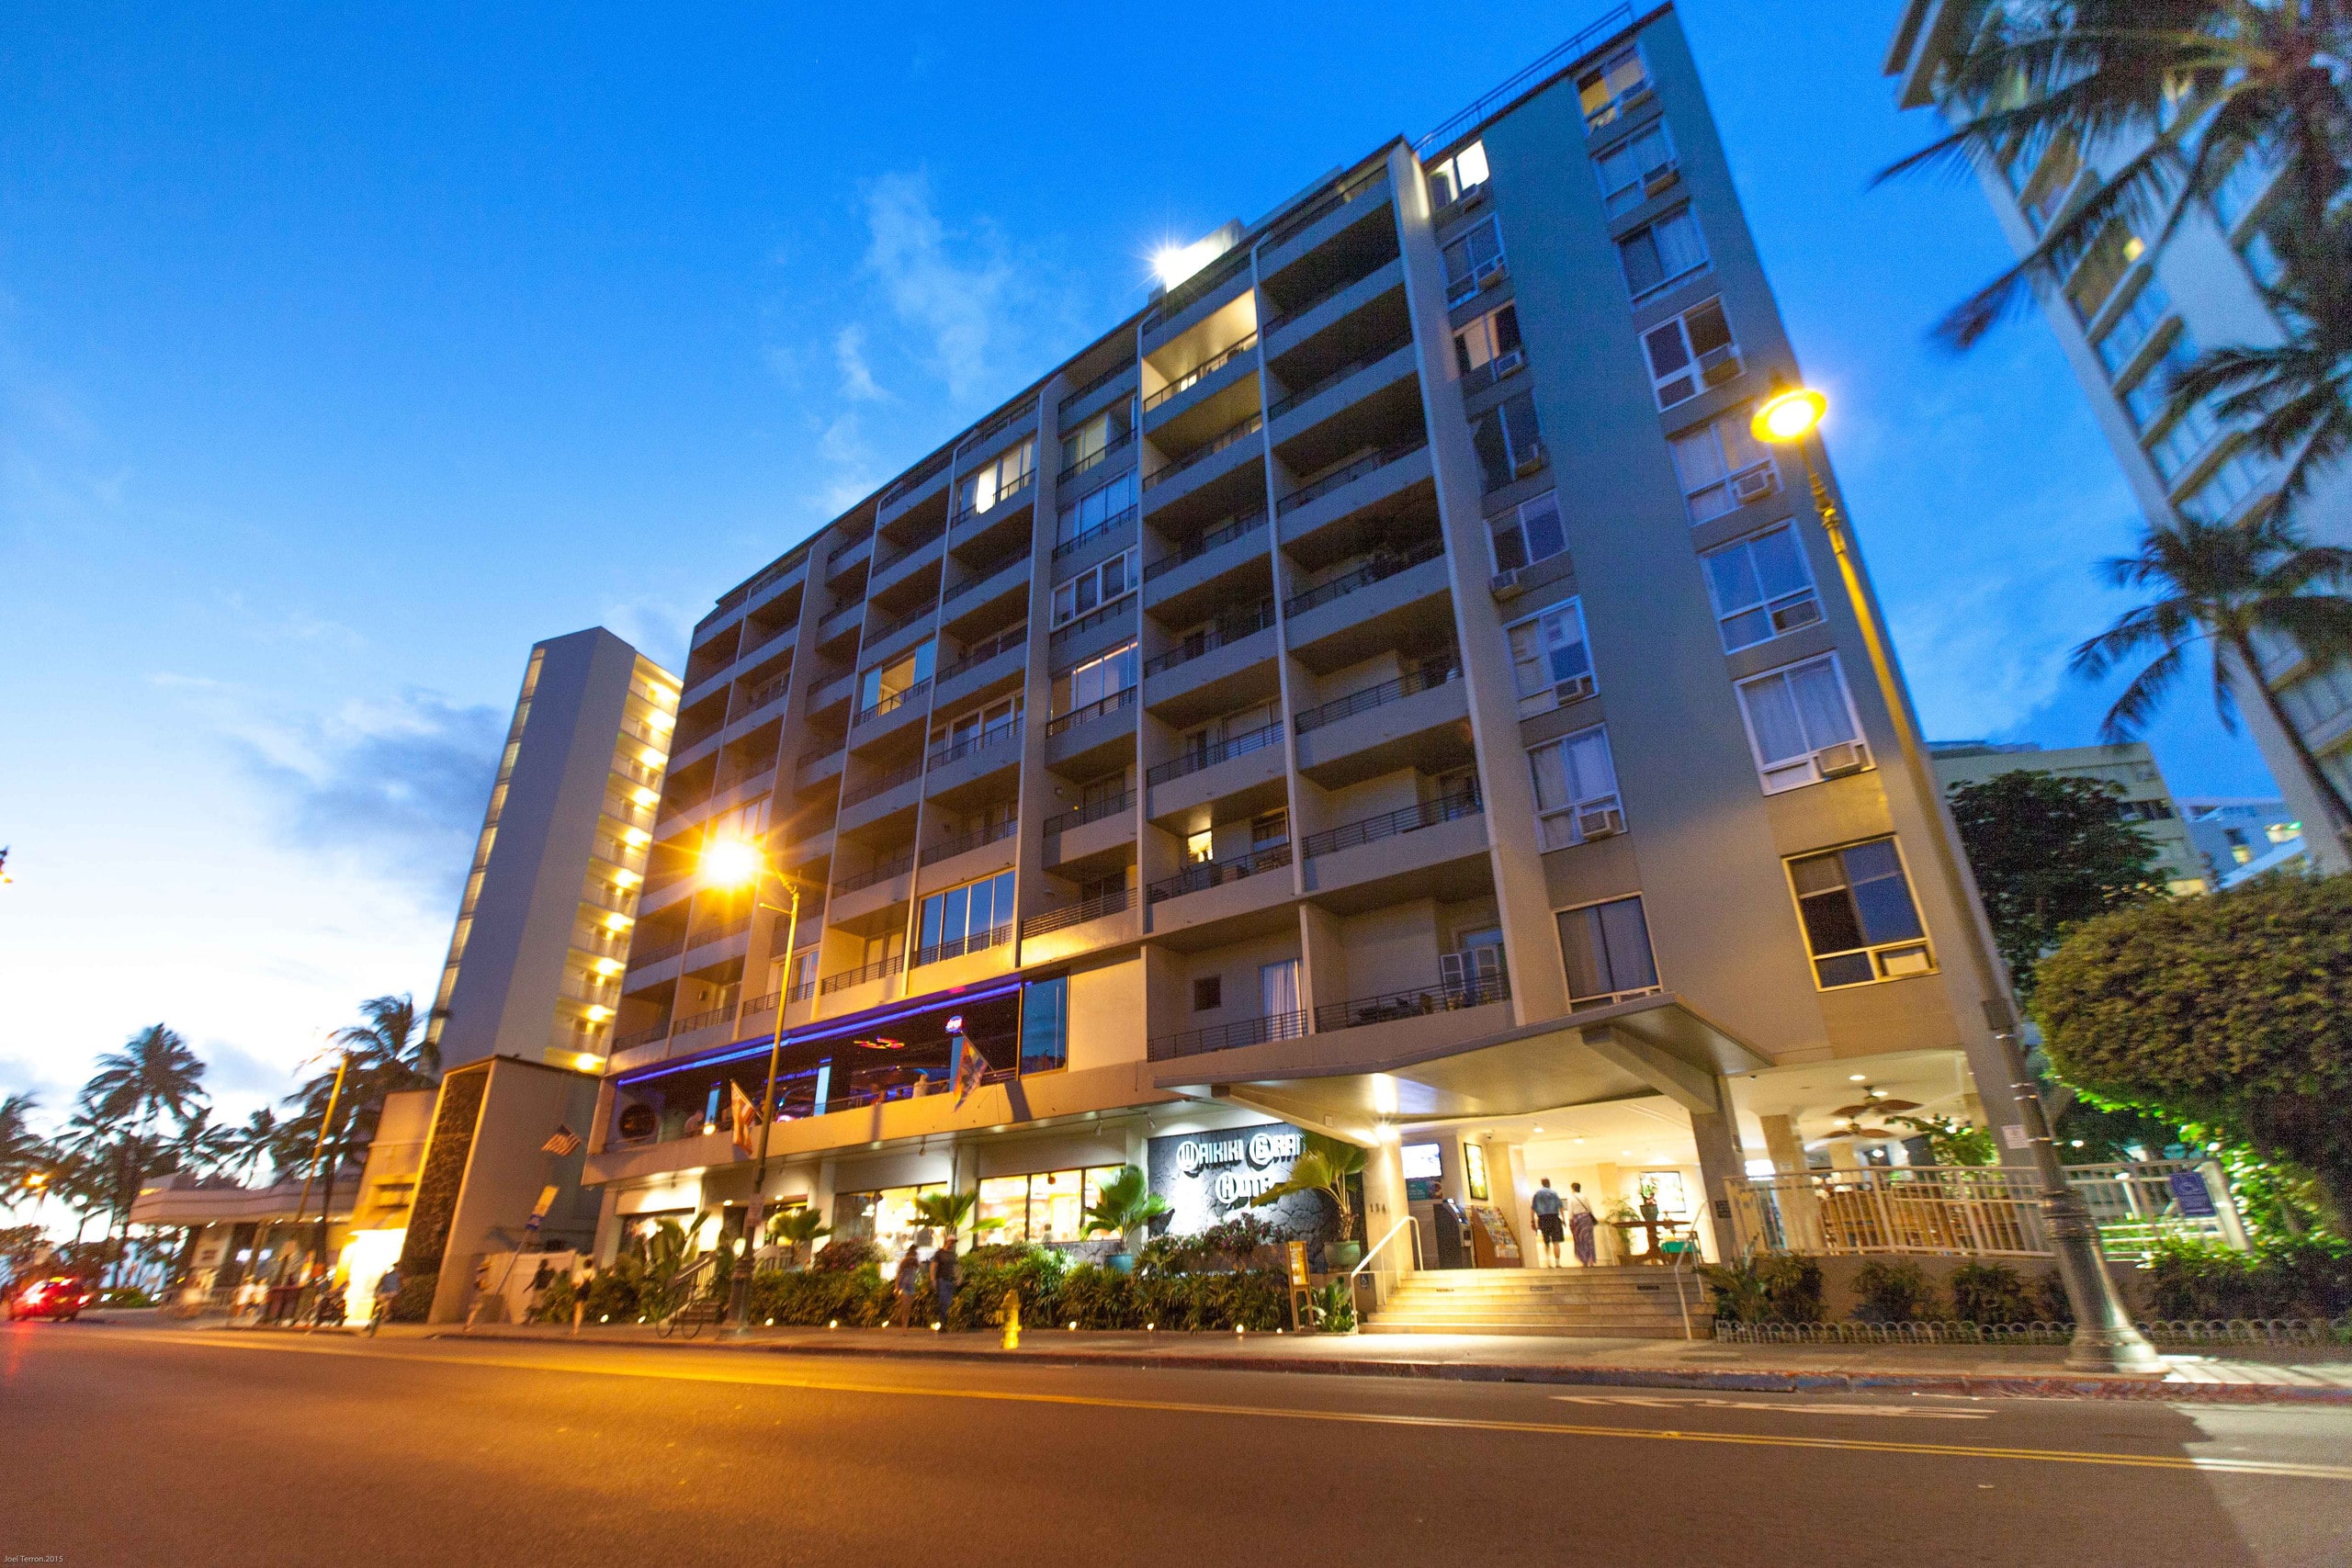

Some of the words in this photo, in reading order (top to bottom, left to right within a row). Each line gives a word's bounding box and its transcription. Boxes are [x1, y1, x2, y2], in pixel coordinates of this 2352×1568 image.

[1177, 1139, 1244, 1171] WAIKIKI
[1249, 1133, 1305, 1165] GRA
[1215, 1171, 1274, 1203] HOTE
